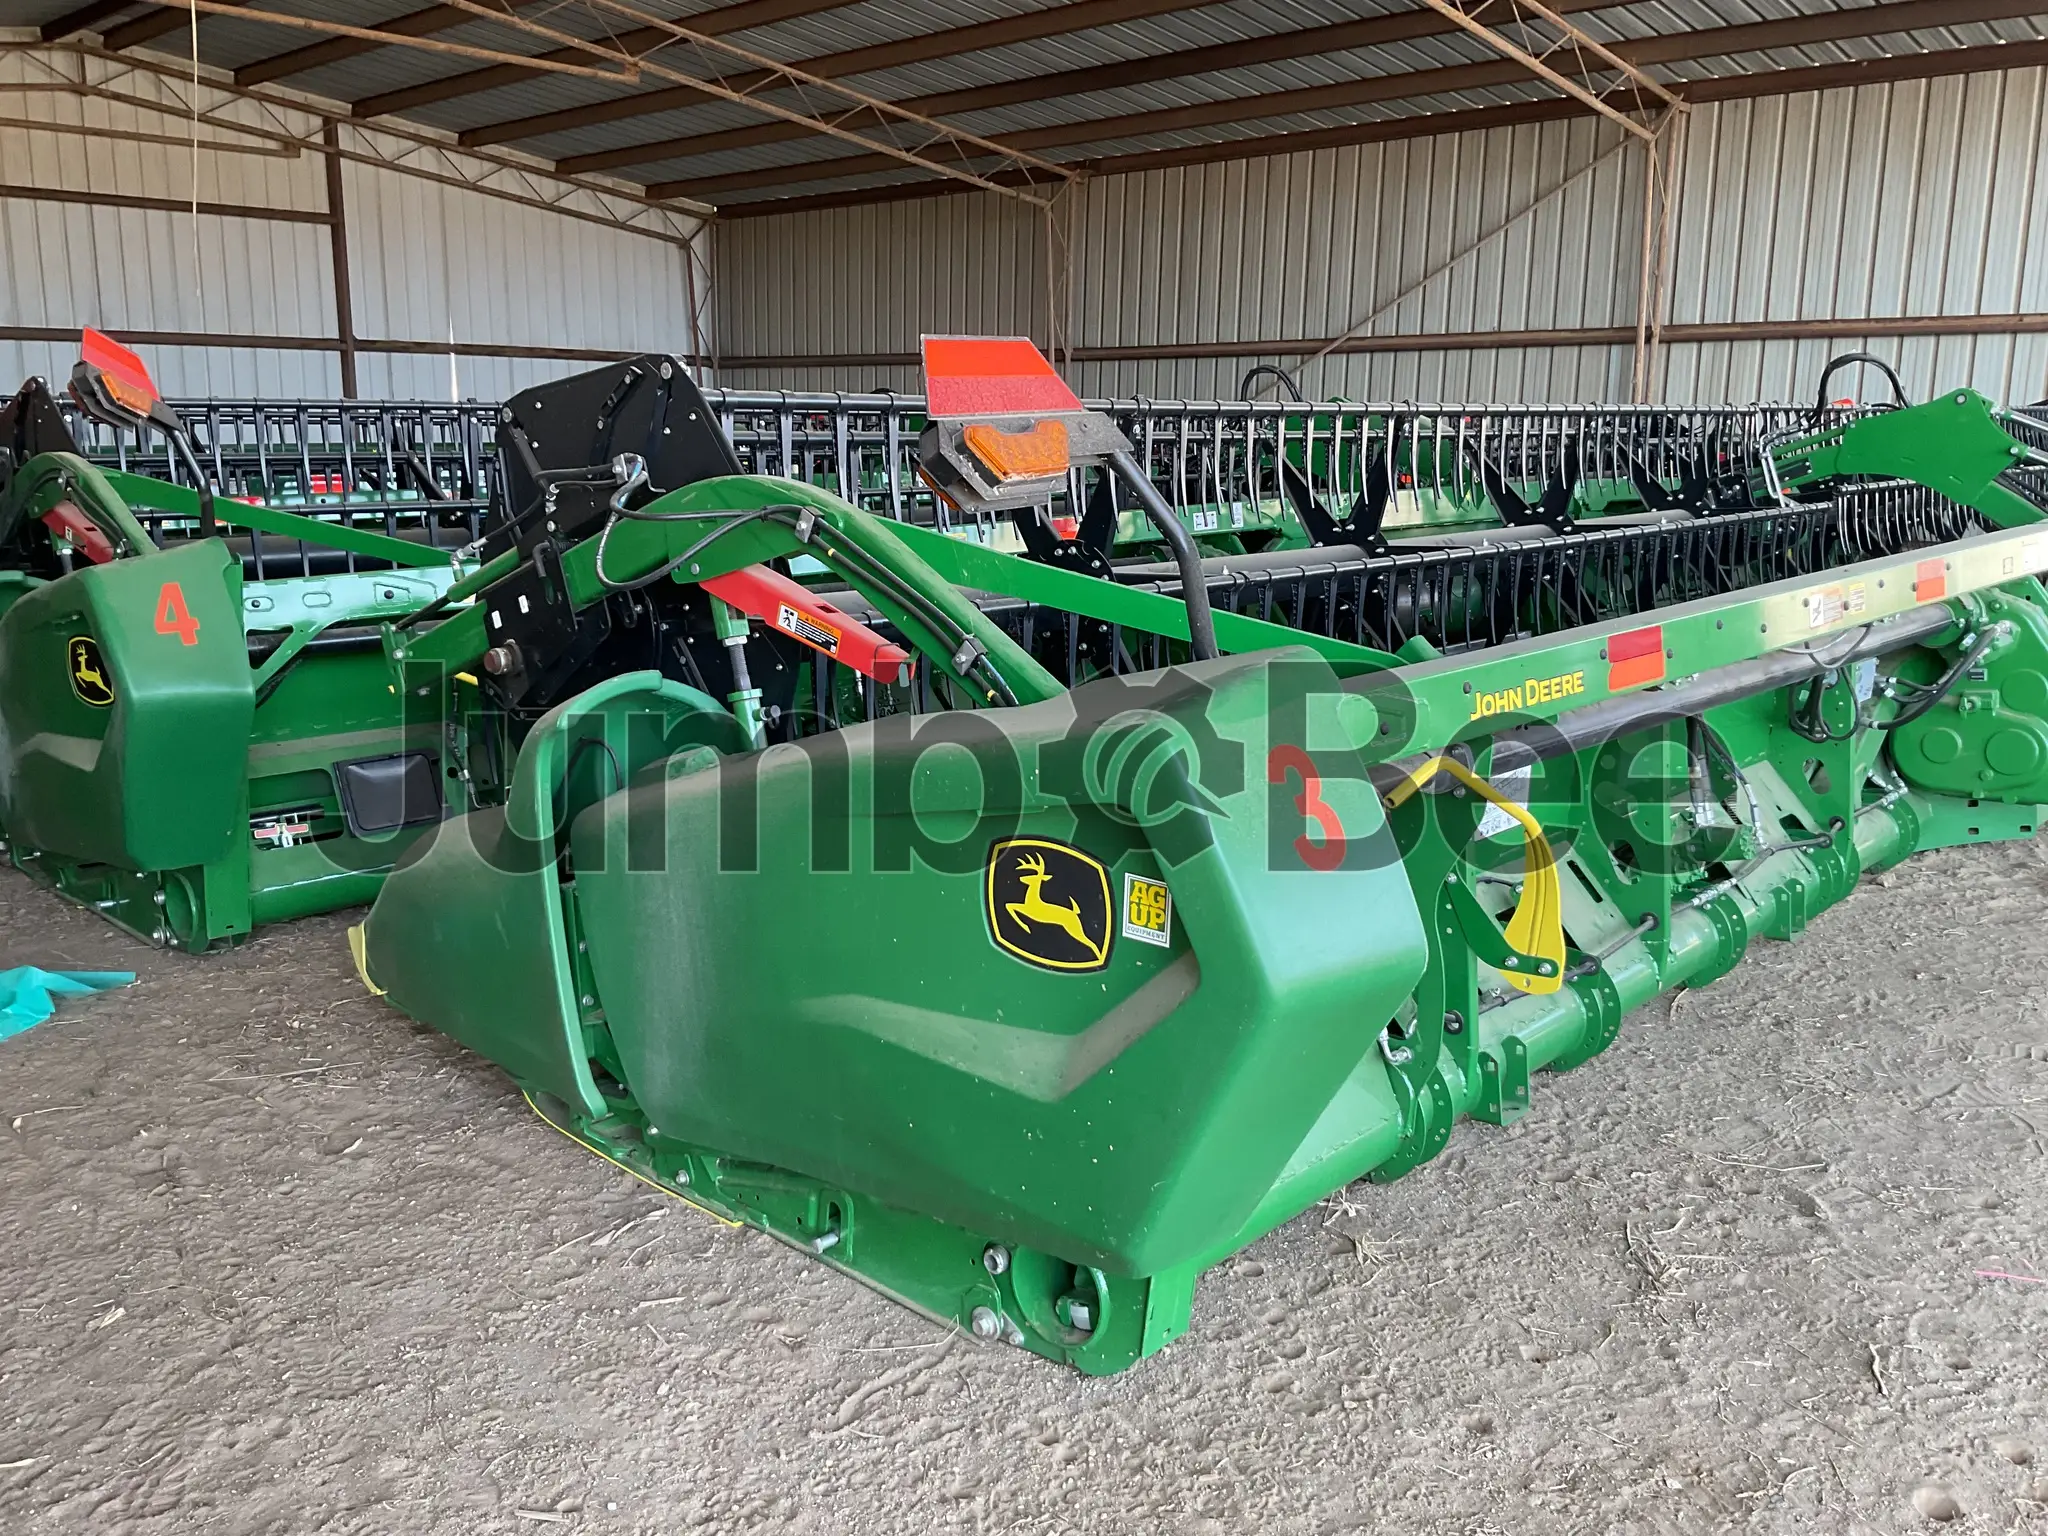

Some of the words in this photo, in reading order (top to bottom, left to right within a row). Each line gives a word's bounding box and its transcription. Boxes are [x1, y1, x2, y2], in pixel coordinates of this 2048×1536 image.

[153, 581, 200, 646] 4
[810, 618, 835, 634] WARNING
[1470, 685, 1523, 721] JOHN
[1525, 669, 1584, 708] DEERE
[1267, 743, 1347, 872] 3
[1130, 881, 1166, 910] AG
[1130, 902, 1166, 930] UP
[1126, 925, 1165, 940] EQUIPMENT
